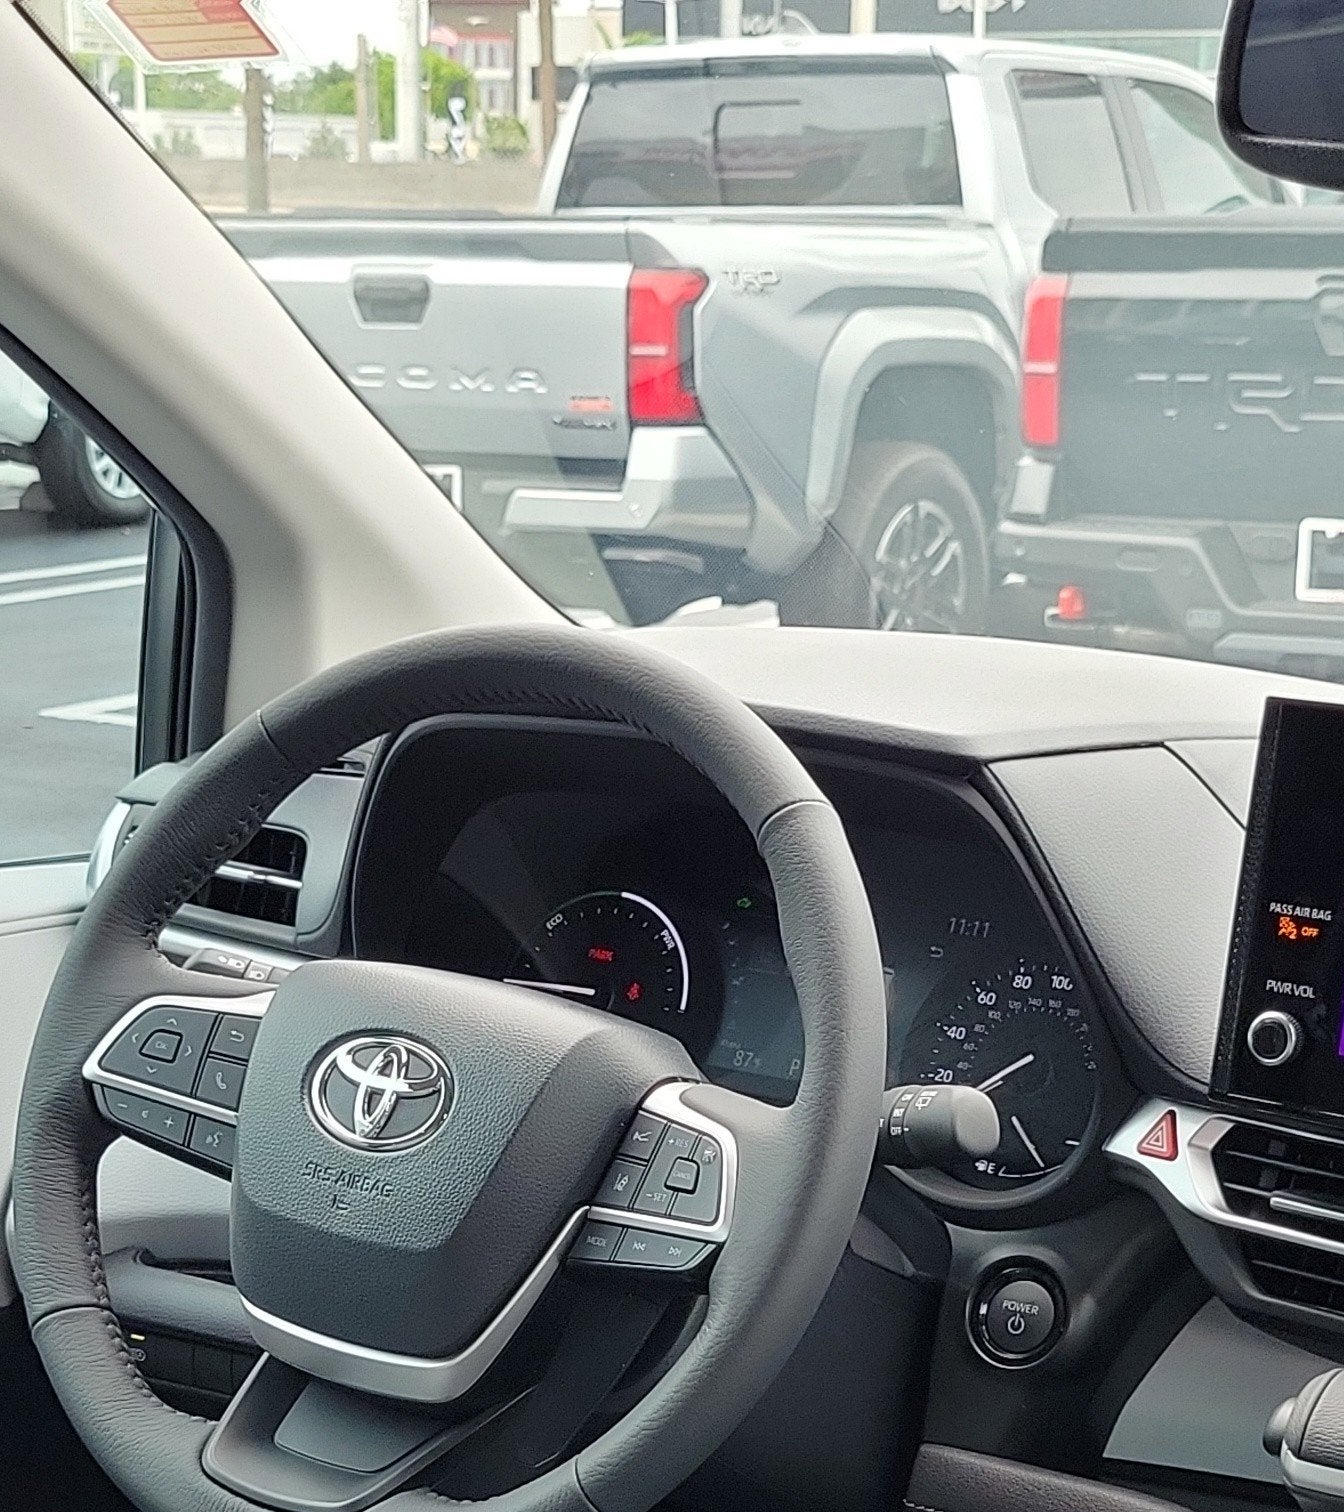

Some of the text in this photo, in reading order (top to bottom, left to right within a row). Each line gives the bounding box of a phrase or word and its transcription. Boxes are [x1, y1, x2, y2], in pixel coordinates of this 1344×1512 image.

[1269, 902, 1332, 921] PASS AIR BAG
[546, 913, 563, 930] ECO
[949, 917, 991, 938] 11:11
[1301, 926, 1320, 938] OFF
[1012, 974, 1032, 990] 80
[1265, 979, 1316, 999] PWR VOL
[977, 990, 996, 1006] 60
[946, 1026, 966, 1040] 40
[934, 1068, 953, 1083] 20
[987, 1162, 997, 1174] E
[334, 1169, 394, 1198] AIRBAG
[1003, 1300, 1039, 1315] POWER
